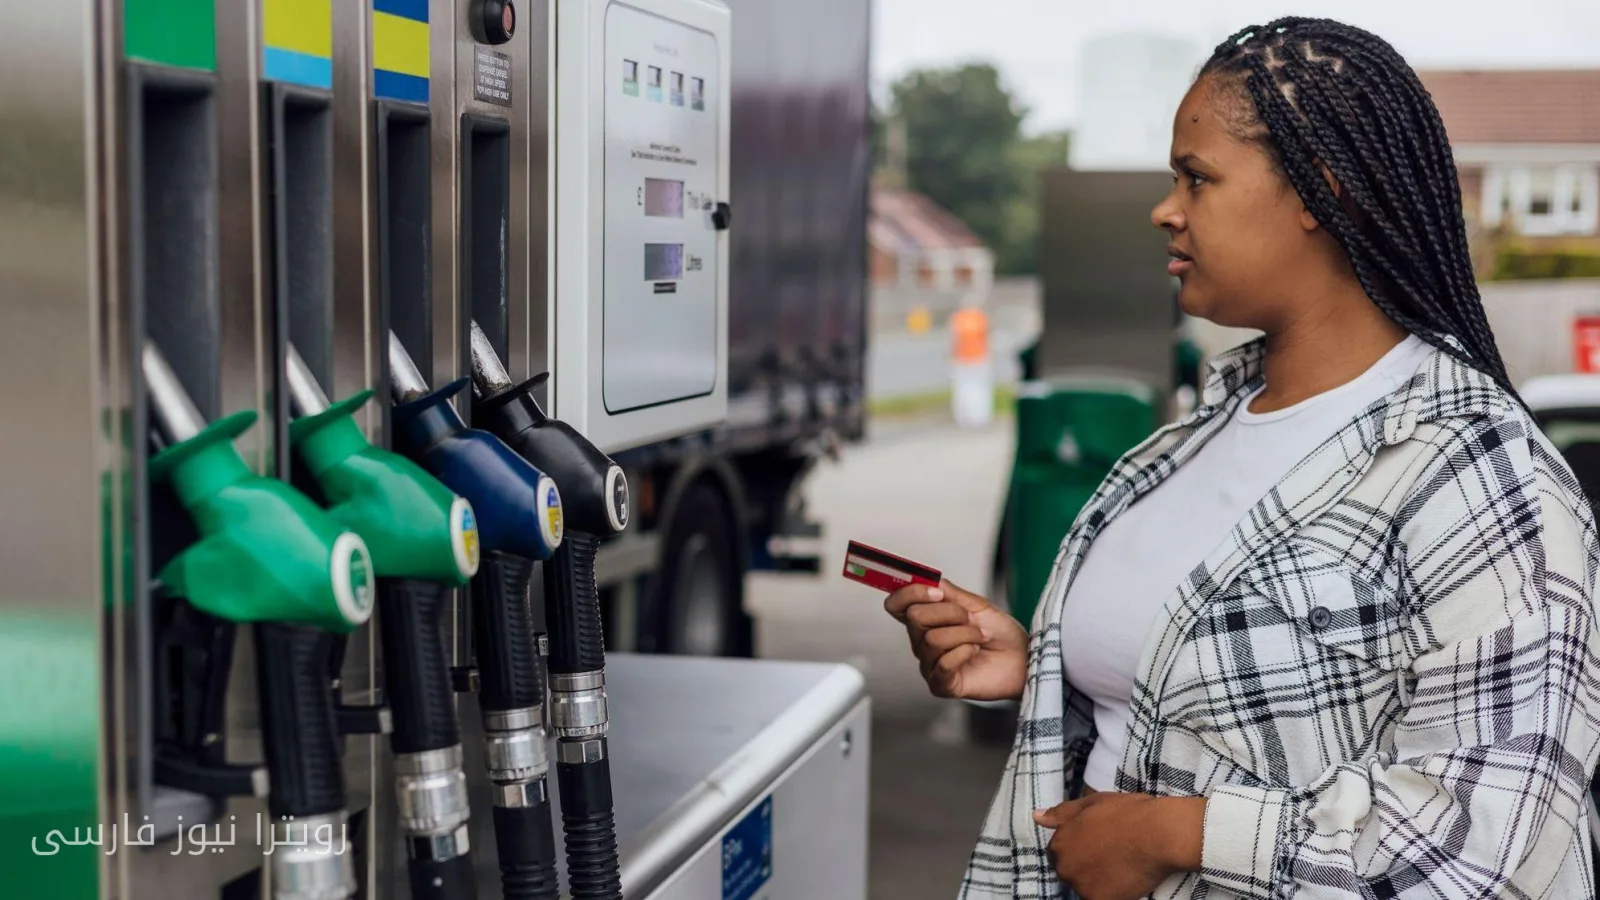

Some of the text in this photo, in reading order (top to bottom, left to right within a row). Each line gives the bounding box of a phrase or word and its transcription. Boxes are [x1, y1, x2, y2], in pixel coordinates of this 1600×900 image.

[478, 53, 490, 63] PRESS
[490, 56, 504, 66] BUTTON
[479, 64, 508, 79] DISPENSE DIESEL
[500, 91, 509, 100] ONLY
